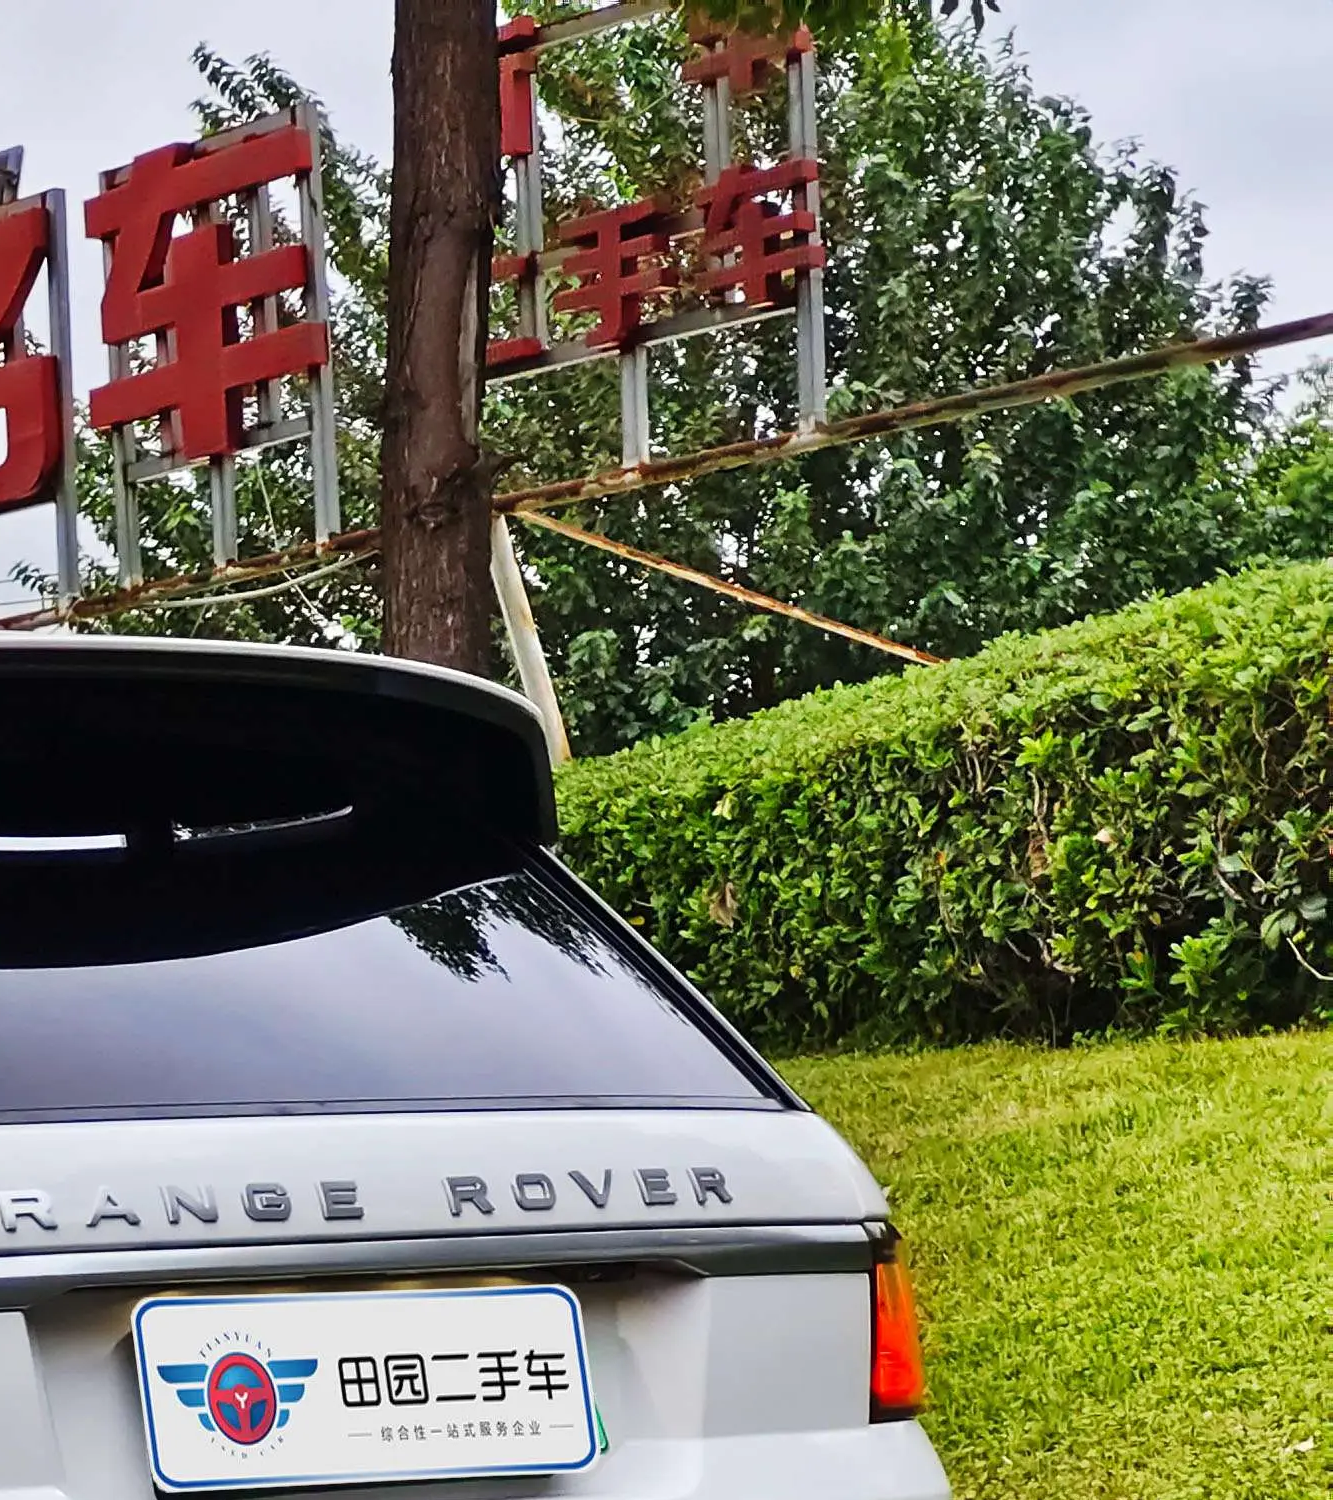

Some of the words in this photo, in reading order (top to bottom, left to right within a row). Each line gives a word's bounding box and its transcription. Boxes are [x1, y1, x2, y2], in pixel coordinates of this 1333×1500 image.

[441, 1166, 734, 1217] ROVER
[337, 1348, 570, 1408] 田园二手车
[380, 1419, 542, 1442] 综合性一站式服务企业
